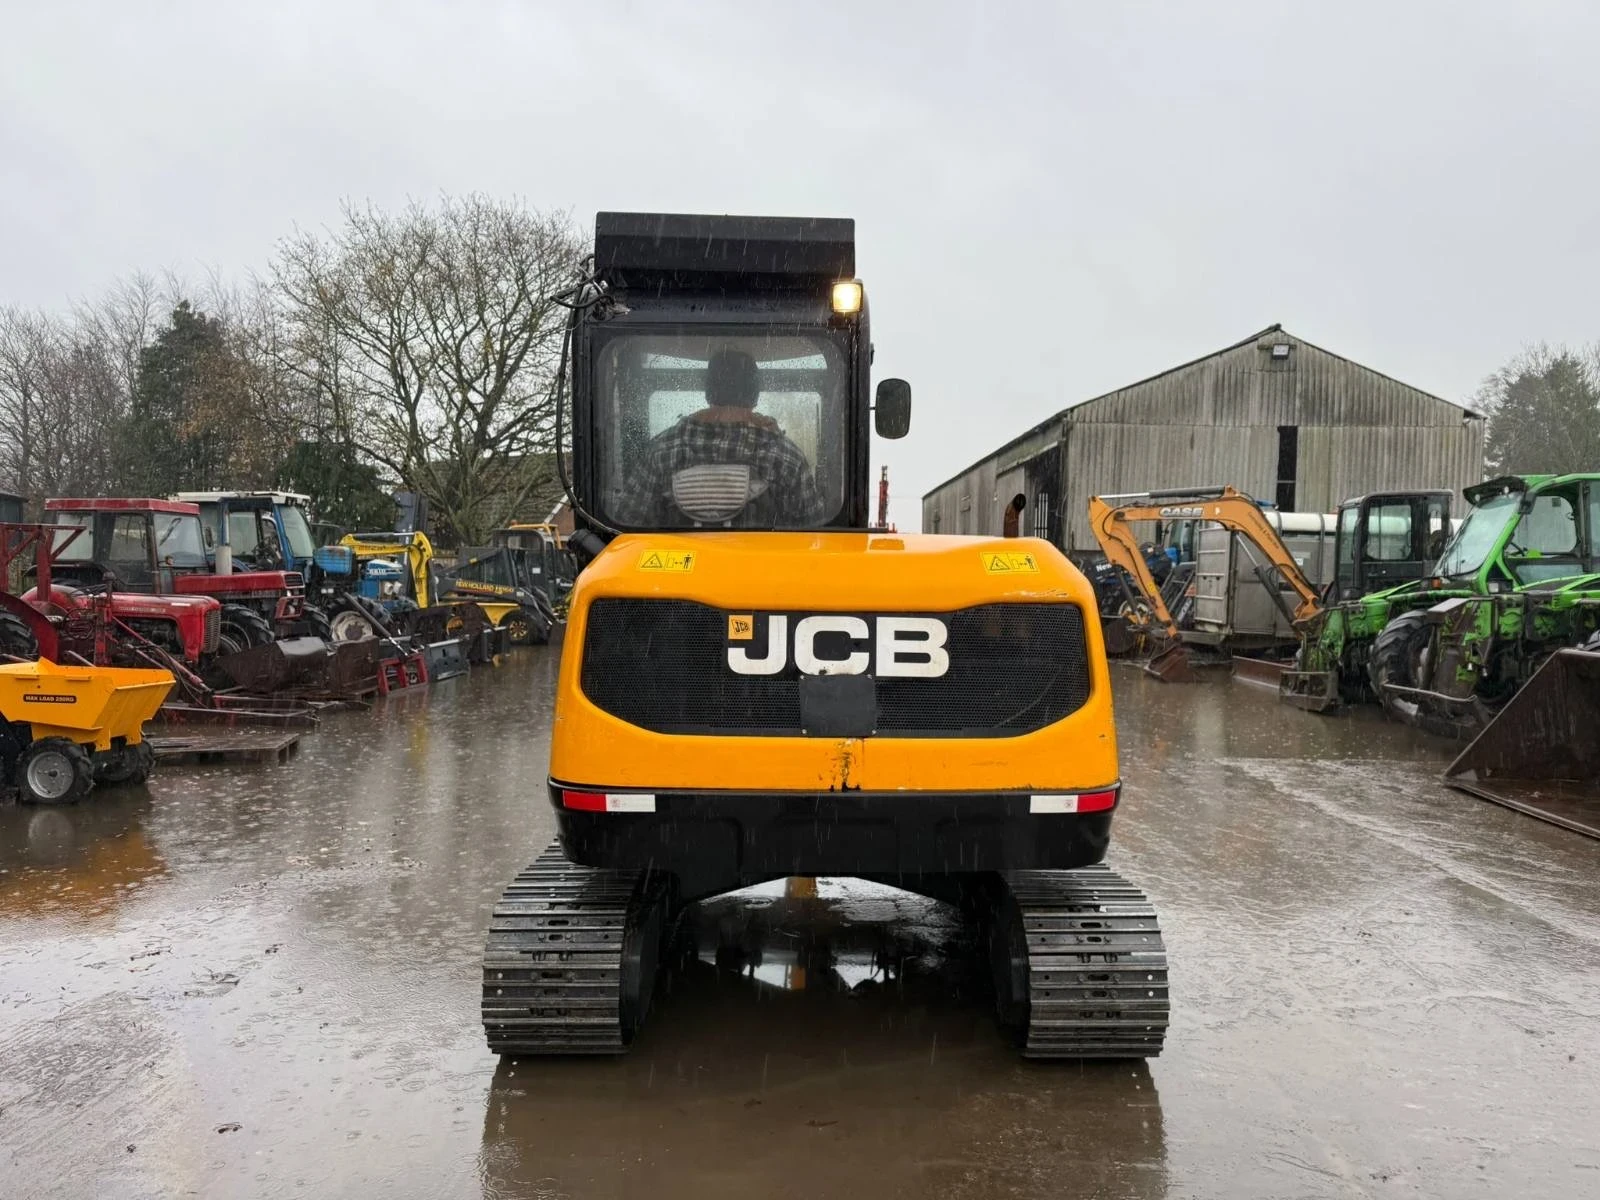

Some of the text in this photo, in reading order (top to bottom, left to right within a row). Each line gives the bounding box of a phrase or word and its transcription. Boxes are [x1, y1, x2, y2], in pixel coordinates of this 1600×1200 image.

[1160, 507, 1204, 518] CASE
[469, 581, 494, 592] HOLLAND
[735, 621, 749, 632] JCB
[727, 615, 949, 678] JCB
